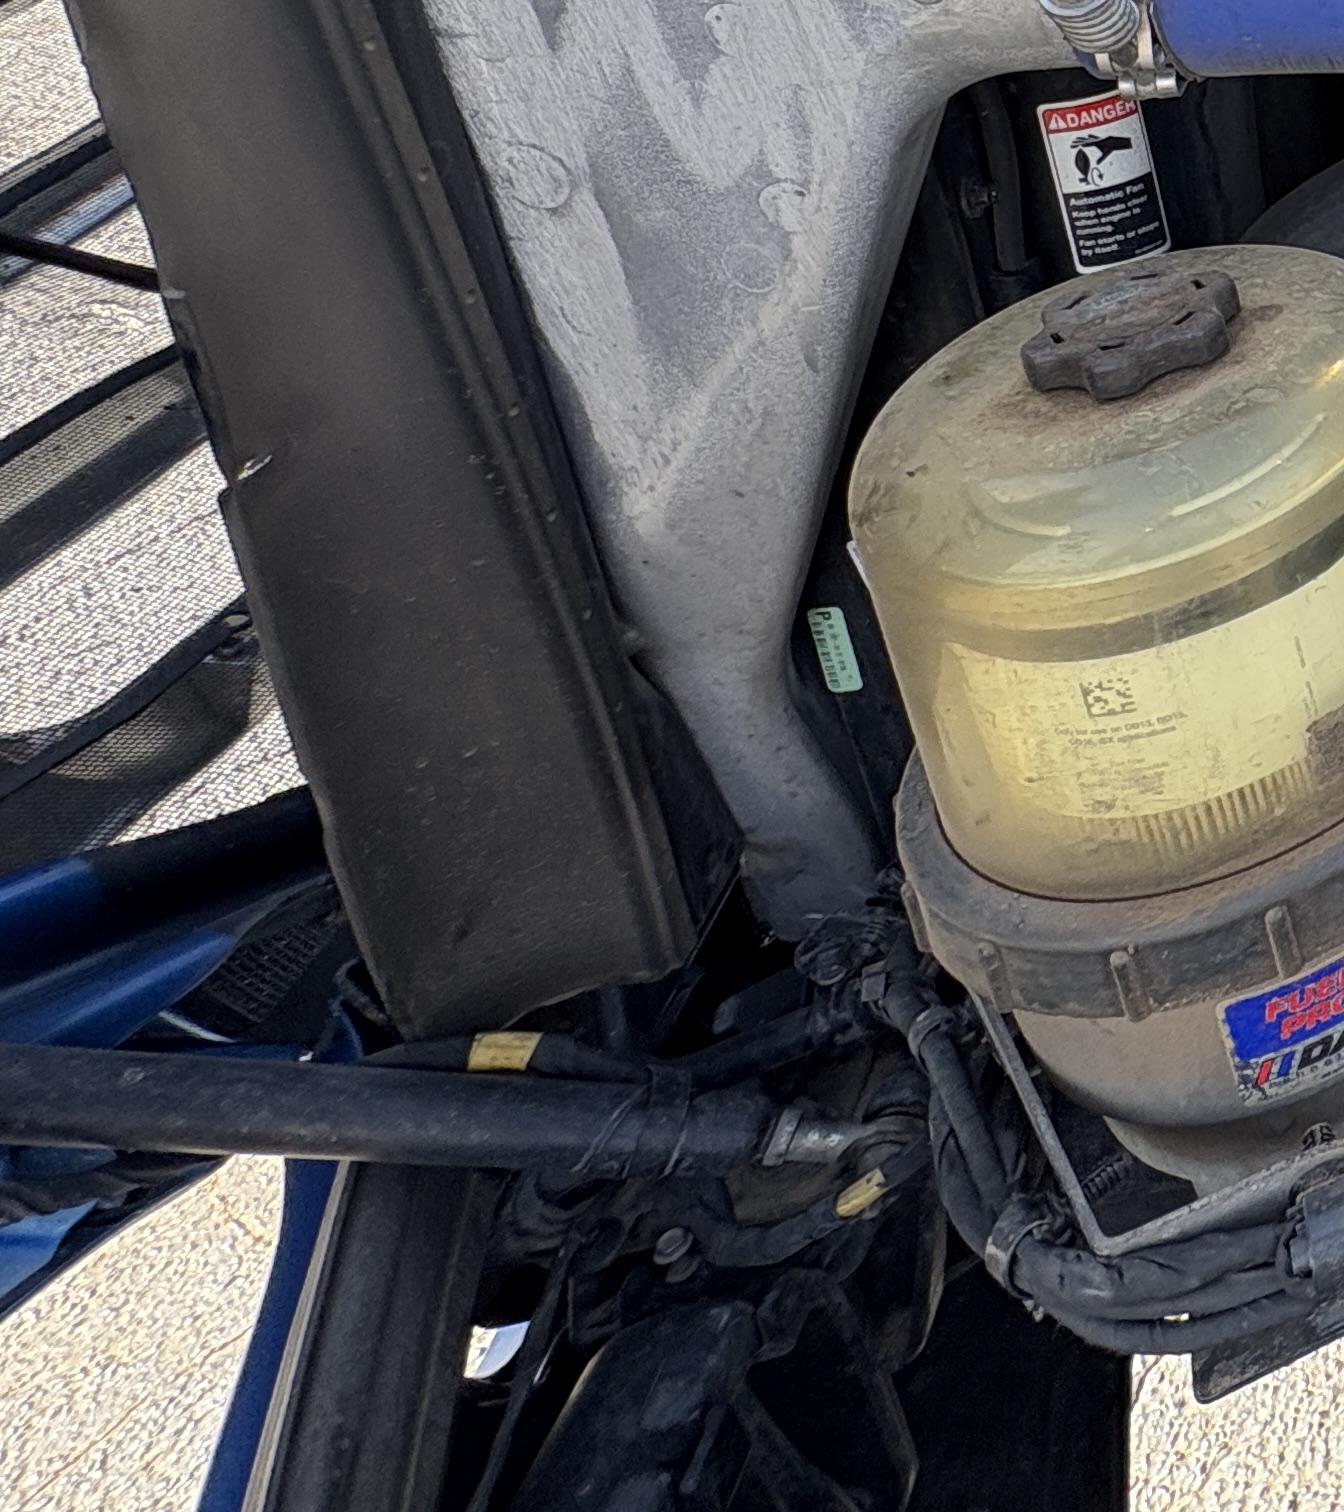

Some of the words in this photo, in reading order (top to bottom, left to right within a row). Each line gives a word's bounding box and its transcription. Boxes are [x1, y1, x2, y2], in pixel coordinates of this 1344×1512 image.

[1066, 98, 1137, 128] DANGER
[1069, 190, 1124, 206] Automatic
[1126, 182, 1145, 195] Fan
[1072, 209, 1097, 218] Keep
[1097, 202, 1126, 214] hands
[1127, 194, 1148, 207] clear
[1074, 218, 1099, 227] when
[1101, 209, 1131, 223] engine
[1132, 207, 1141, 215] is
[1079, 239, 1096, 247] Fan
[1097, 233, 1125, 245] starts
[1126, 230, 1136, 238] or
